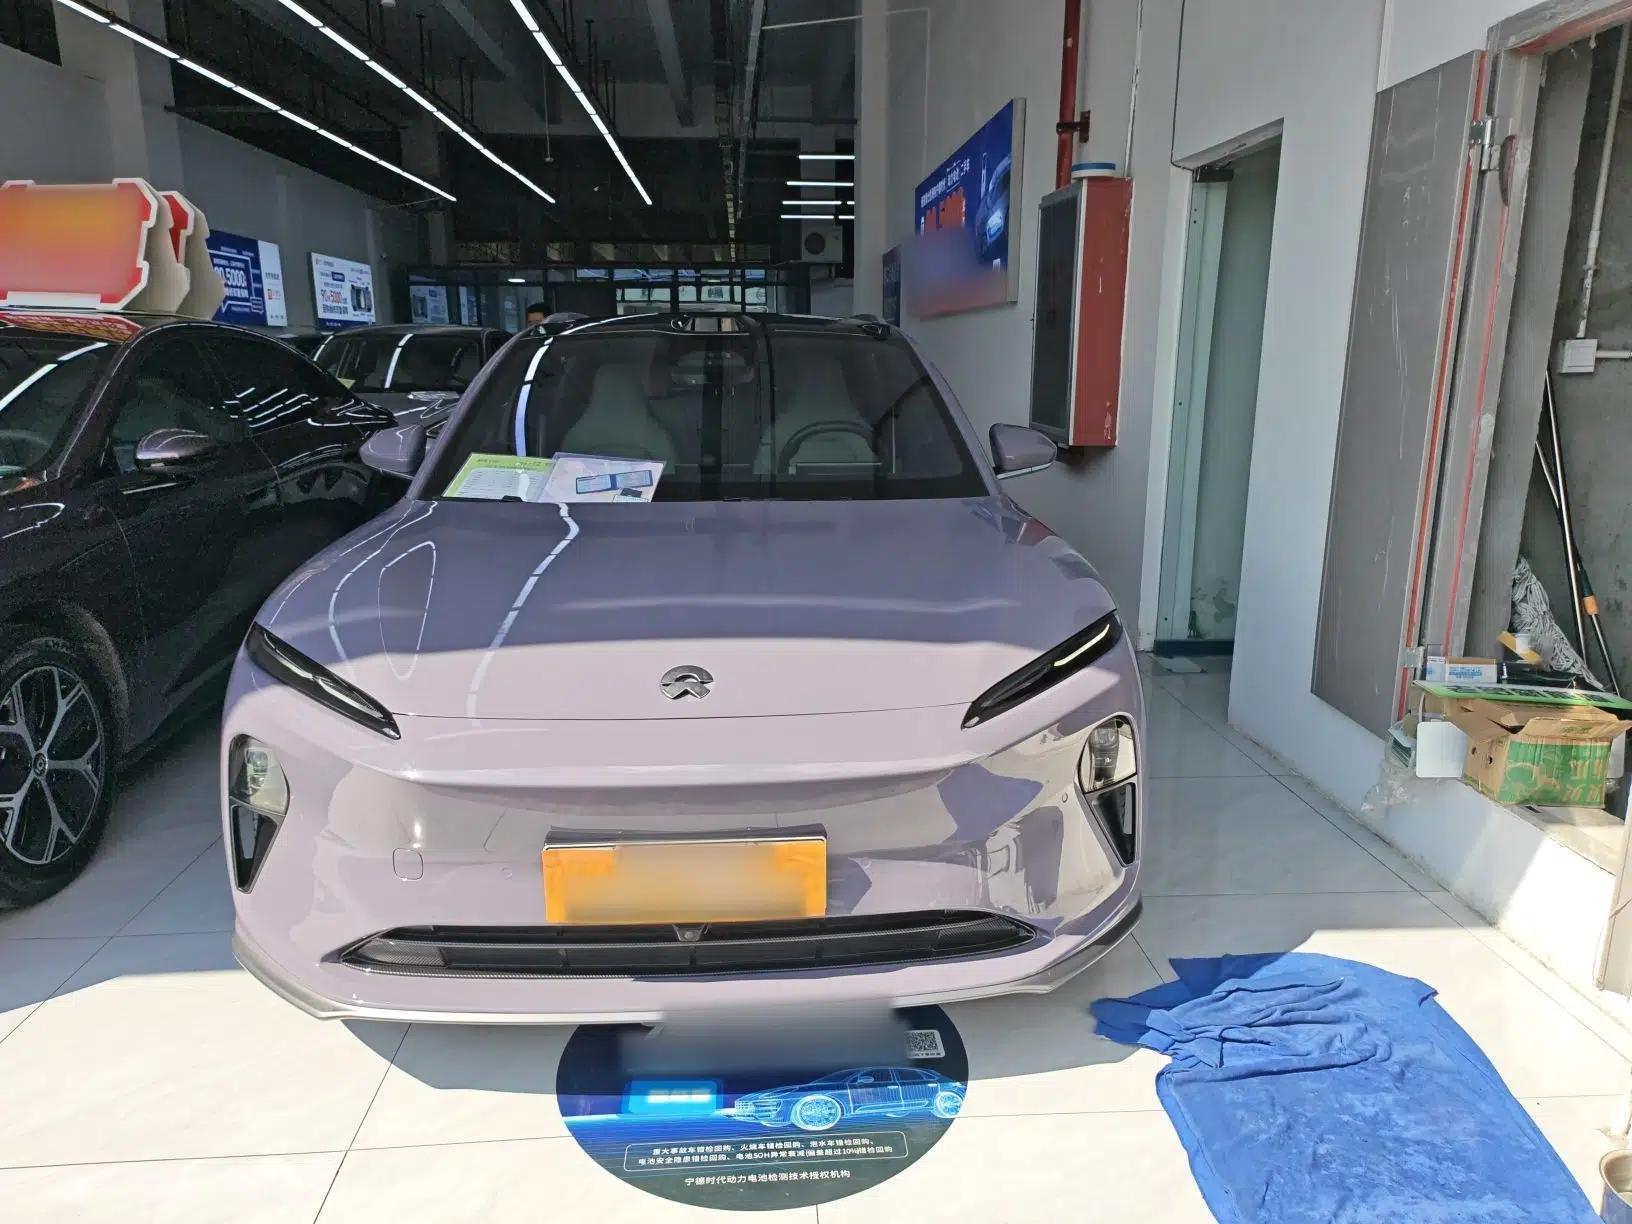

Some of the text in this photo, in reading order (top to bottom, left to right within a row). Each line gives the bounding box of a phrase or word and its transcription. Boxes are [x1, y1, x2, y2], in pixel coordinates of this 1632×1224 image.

[684, 1169, 851, 1187] 宁德时代动力电池检测技术授权机构
